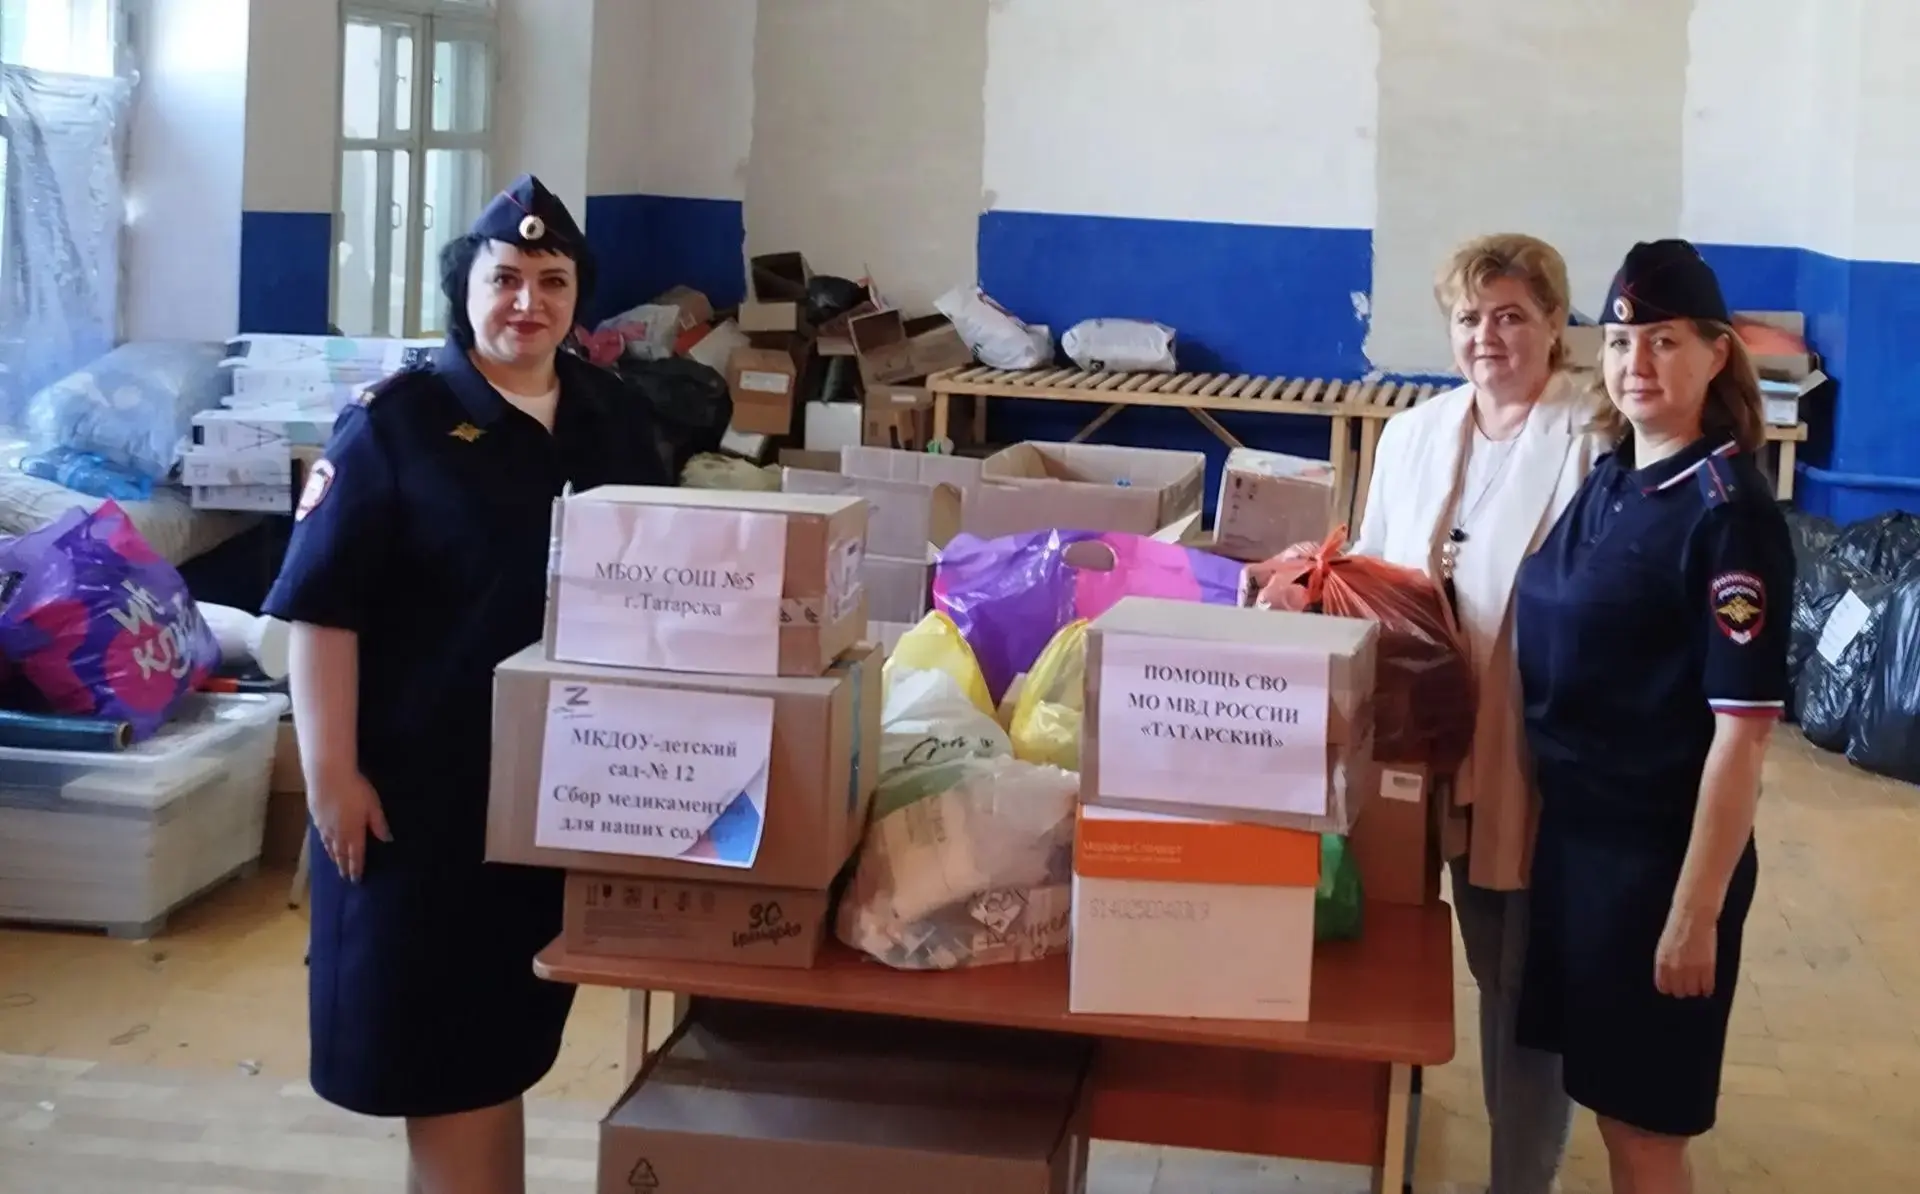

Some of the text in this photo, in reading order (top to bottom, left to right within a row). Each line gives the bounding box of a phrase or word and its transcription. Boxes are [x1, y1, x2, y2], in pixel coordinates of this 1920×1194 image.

[594, 562, 756, 591] МБОУ СОШ №5
[624, 592, 722, 618] г.Татарска
[1144, 664, 1288, 693] ПОМОЩЬ СВО
[564, 686, 590, 706] Z
[1128, 692, 1299, 725] МО МВД РОССИИ
[571, 728, 738, 757] МКДОУ-детский
[1140, 721, 1284, 748] «ТАТАРСКИЙ»
[675, 765, 696, 782] 12
[552, 784, 602, 809] Сбор
[559, 816, 595, 832] для
[600, 821, 665, 838] наших
